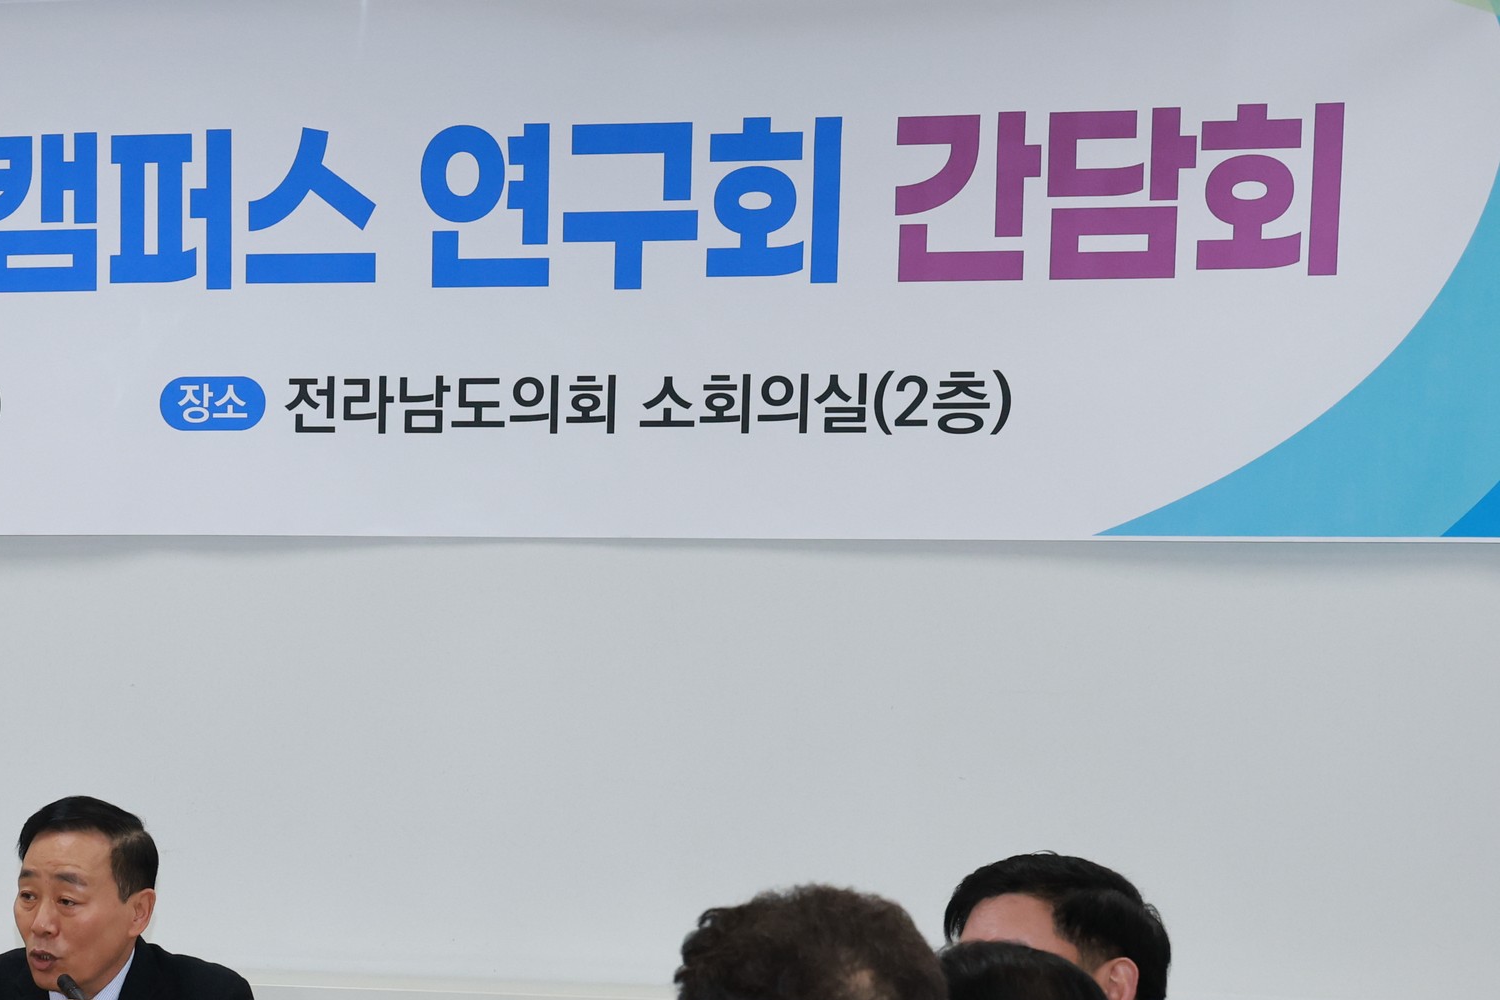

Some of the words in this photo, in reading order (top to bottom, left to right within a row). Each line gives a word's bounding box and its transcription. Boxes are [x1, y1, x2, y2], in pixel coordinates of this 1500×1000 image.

[420, 116, 843, 290] 연구회
[895, 102, 1345, 282] 간담회
[176, 384, 248, 424] 장소
[284, 374, 617, 435] 전라남도의회
[639, 370, 1012, 435] 소회의실(2층)
